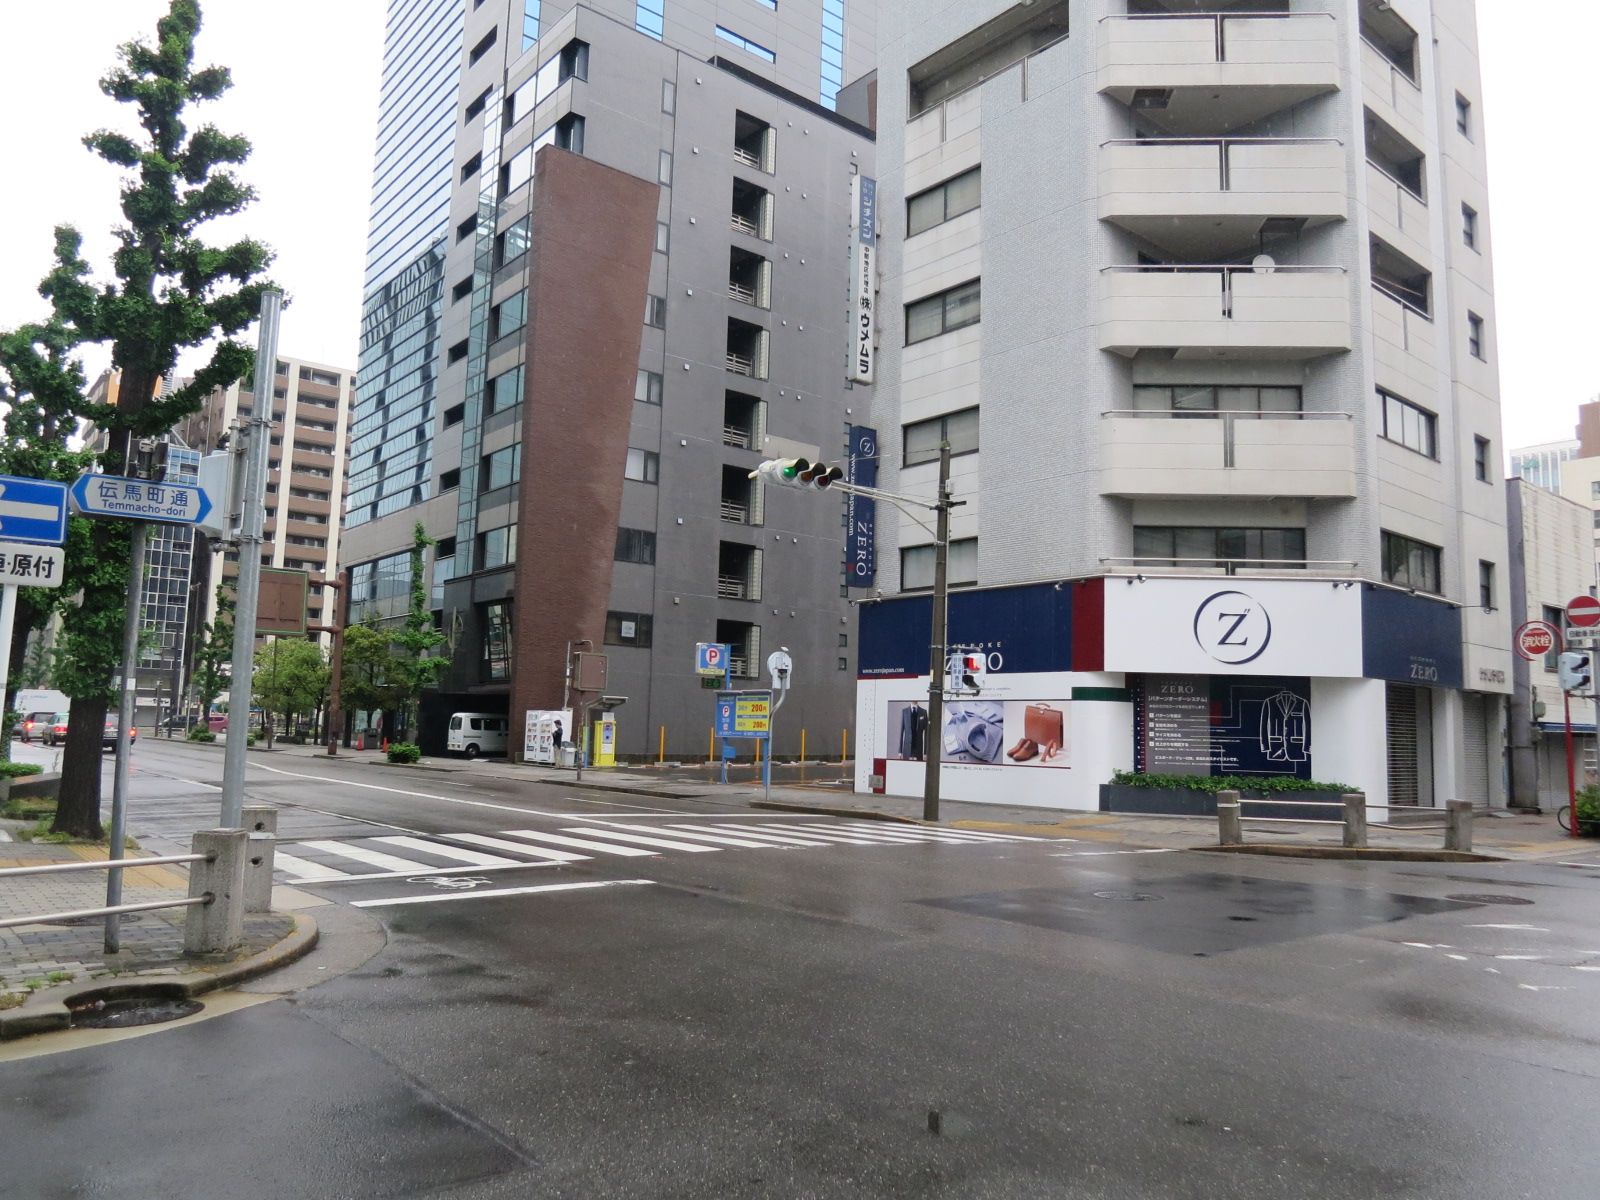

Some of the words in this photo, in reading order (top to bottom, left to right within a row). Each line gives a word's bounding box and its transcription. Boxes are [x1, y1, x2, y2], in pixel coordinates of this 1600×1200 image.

[98, 481, 188, 507] 伝馬町通
[102, 499, 186, 517] Temmacho-dori
[856, 522, 868, 576] ZERO
[1523, 635, 1551, 648] 消火栓
[1410, 663, 1438, 681] ZERO
[1161, 685, 1194, 694] ZERO
